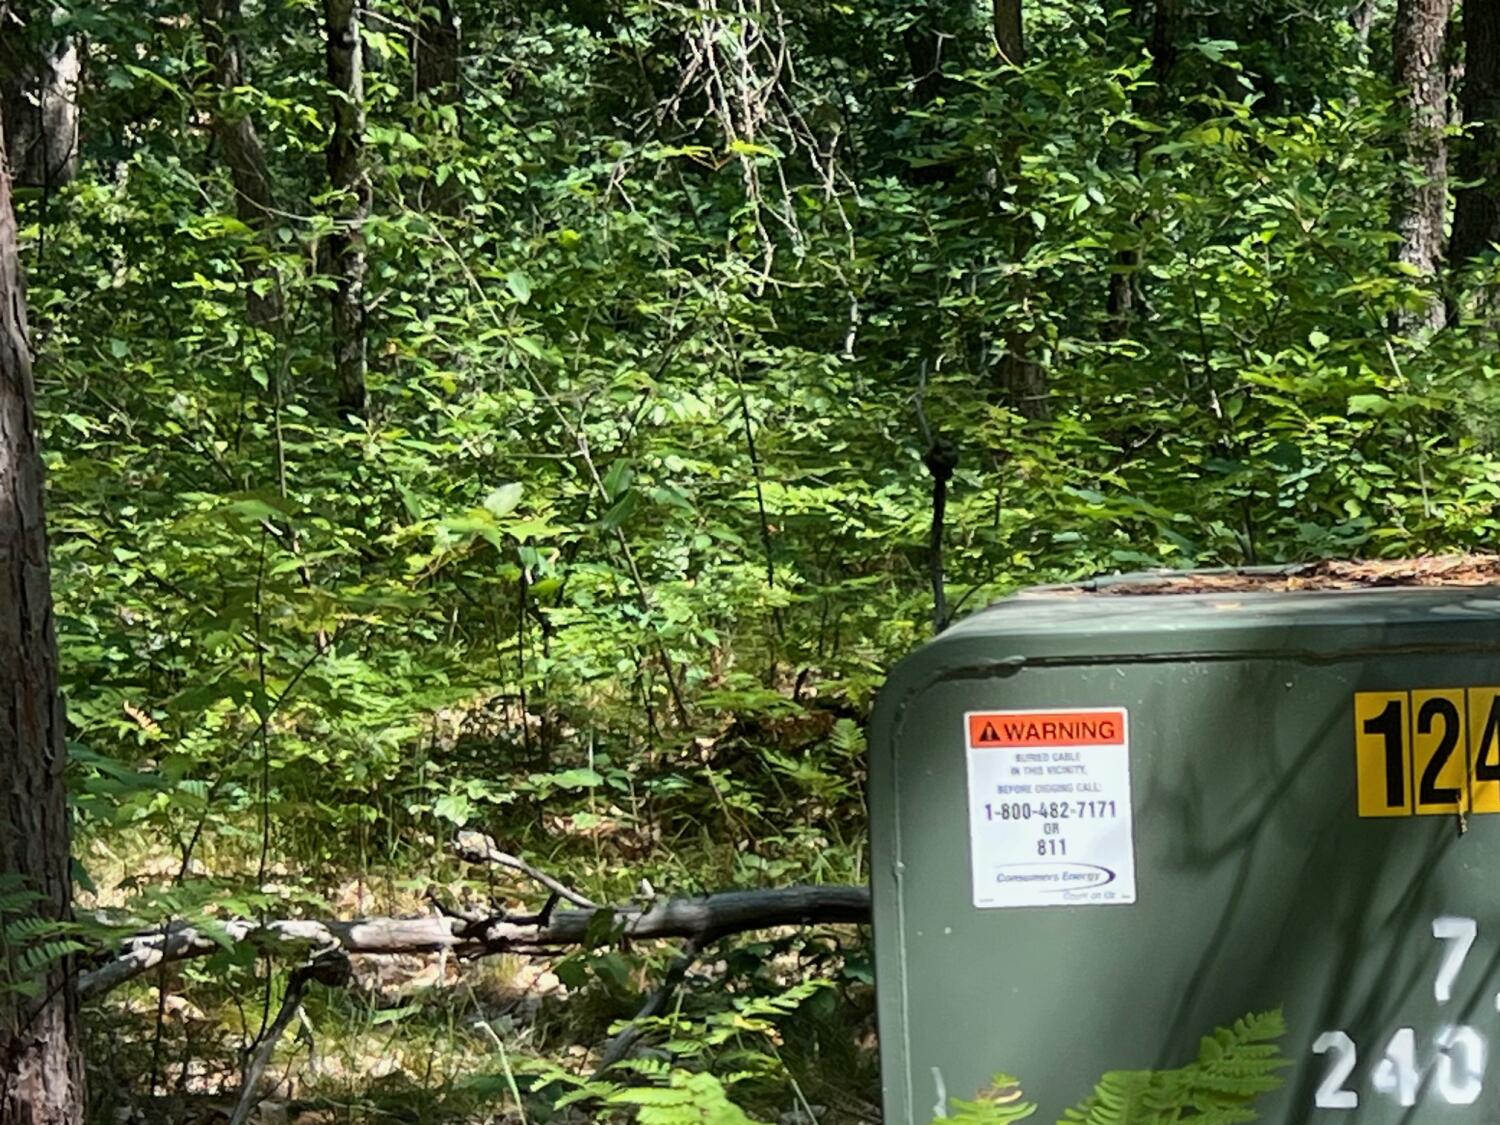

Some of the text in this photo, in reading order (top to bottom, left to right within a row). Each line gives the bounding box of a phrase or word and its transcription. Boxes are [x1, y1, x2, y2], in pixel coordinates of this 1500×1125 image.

[1004, 721, 1115, 740] WARNING
[1052, 752, 1081, 762] CABLE
[1011, 767, 1020, 775] IN
[1024, 766, 1044, 775] THIS
[997, 784, 1032, 794] BEFORE
[1035, 783, 1073, 793] DIGGING
[985, 800, 1116, 821] 1-800-482-7171
[1043, 823, 1060, 835] OR
[1037, 838, 1066, 855] 811
[996, 870, 1101, 883] Consumers Energy
